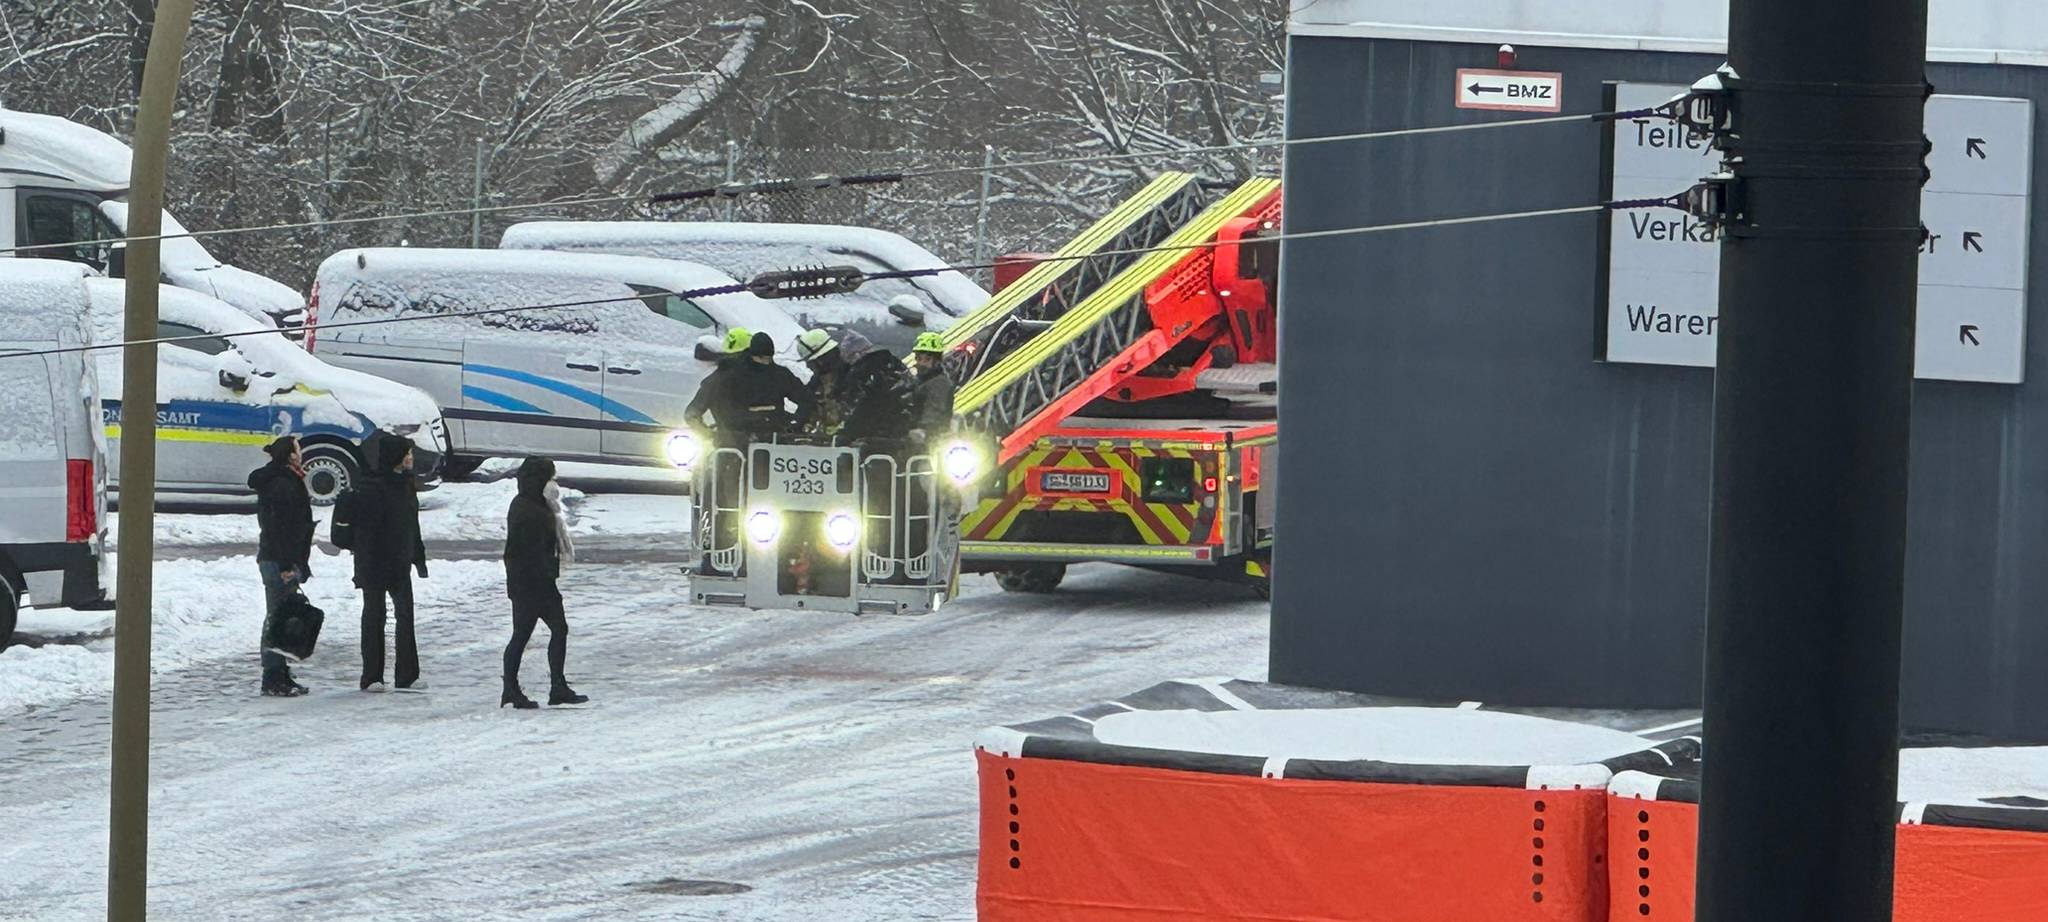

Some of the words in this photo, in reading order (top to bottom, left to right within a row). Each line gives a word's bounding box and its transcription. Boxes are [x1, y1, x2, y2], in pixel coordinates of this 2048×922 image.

[1506, 84, 1552, 99] BMZ
[773, 457, 833, 475] SG-SG
[783, 479, 825, 495] 1233
